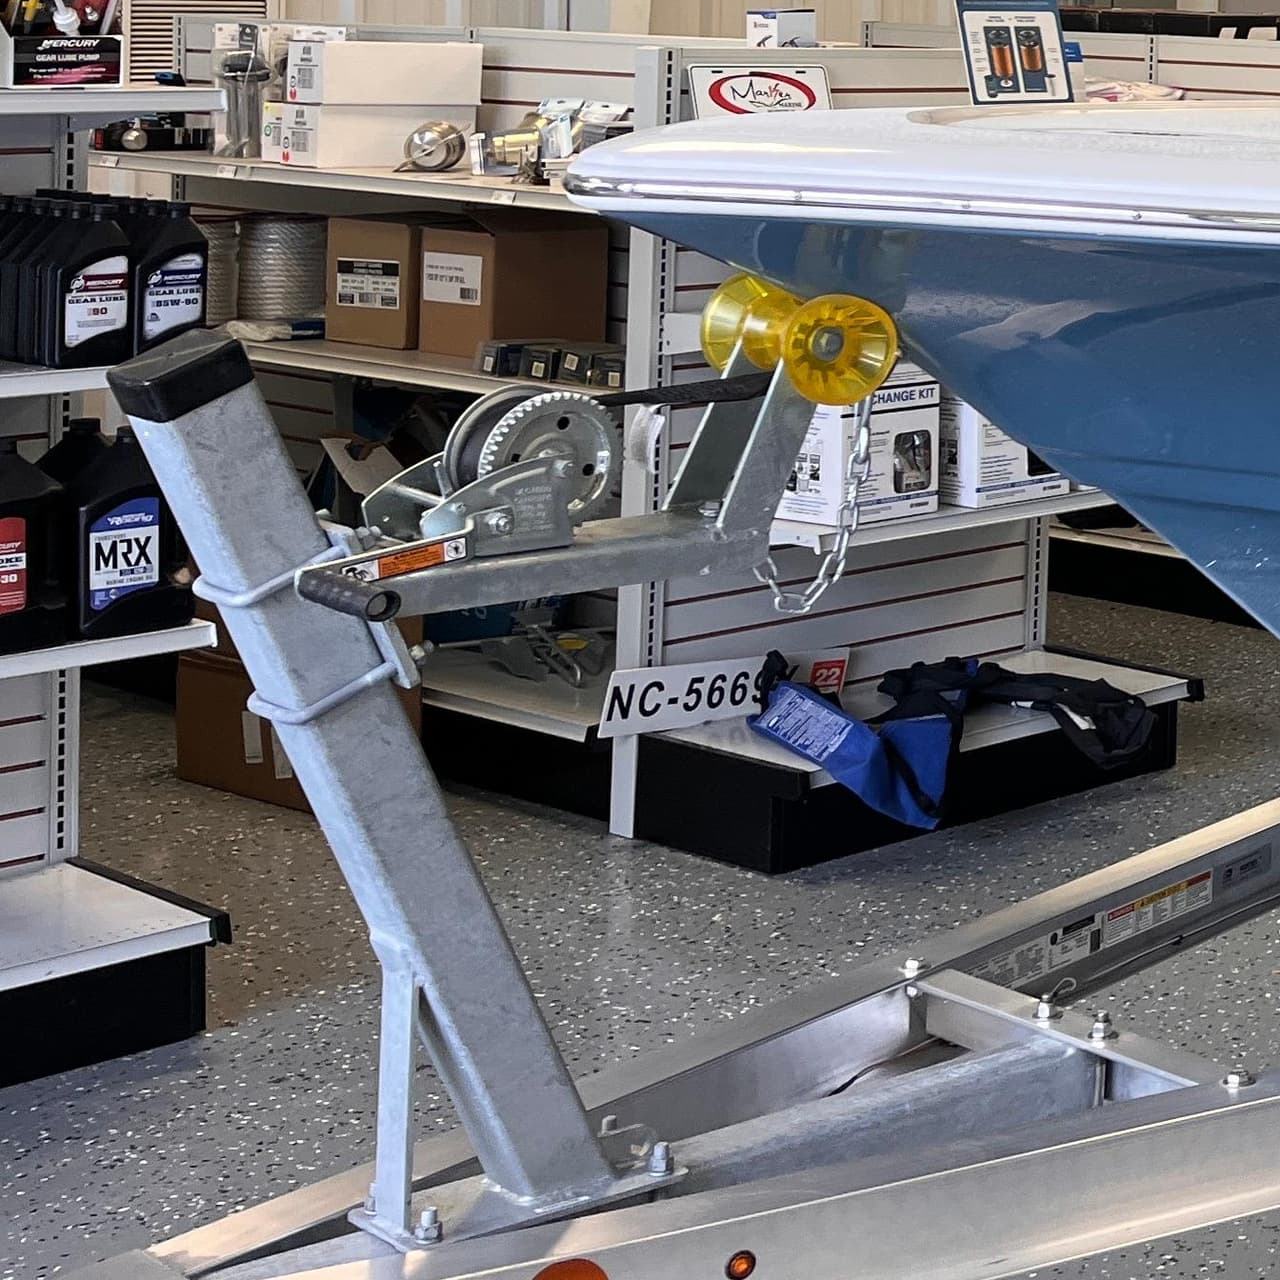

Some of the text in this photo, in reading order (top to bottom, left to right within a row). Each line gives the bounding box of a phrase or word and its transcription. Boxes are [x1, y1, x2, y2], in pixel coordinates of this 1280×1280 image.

[37, 39, 100, 51] MERCURY
[36, 53, 57, 62] GEAR
[164, 273, 202, 281] MERCURY
[86, 278, 124, 286] MERCURY
[68, 296, 98, 305] GEAR
[872, 388, 936, 405] CHANGE KIT
[95, 536, 152, 571] MRX
[0, 556, 23, 564] OKE
[0, 574, 18, 583] 30
[814, 668, 841, 685] 22
